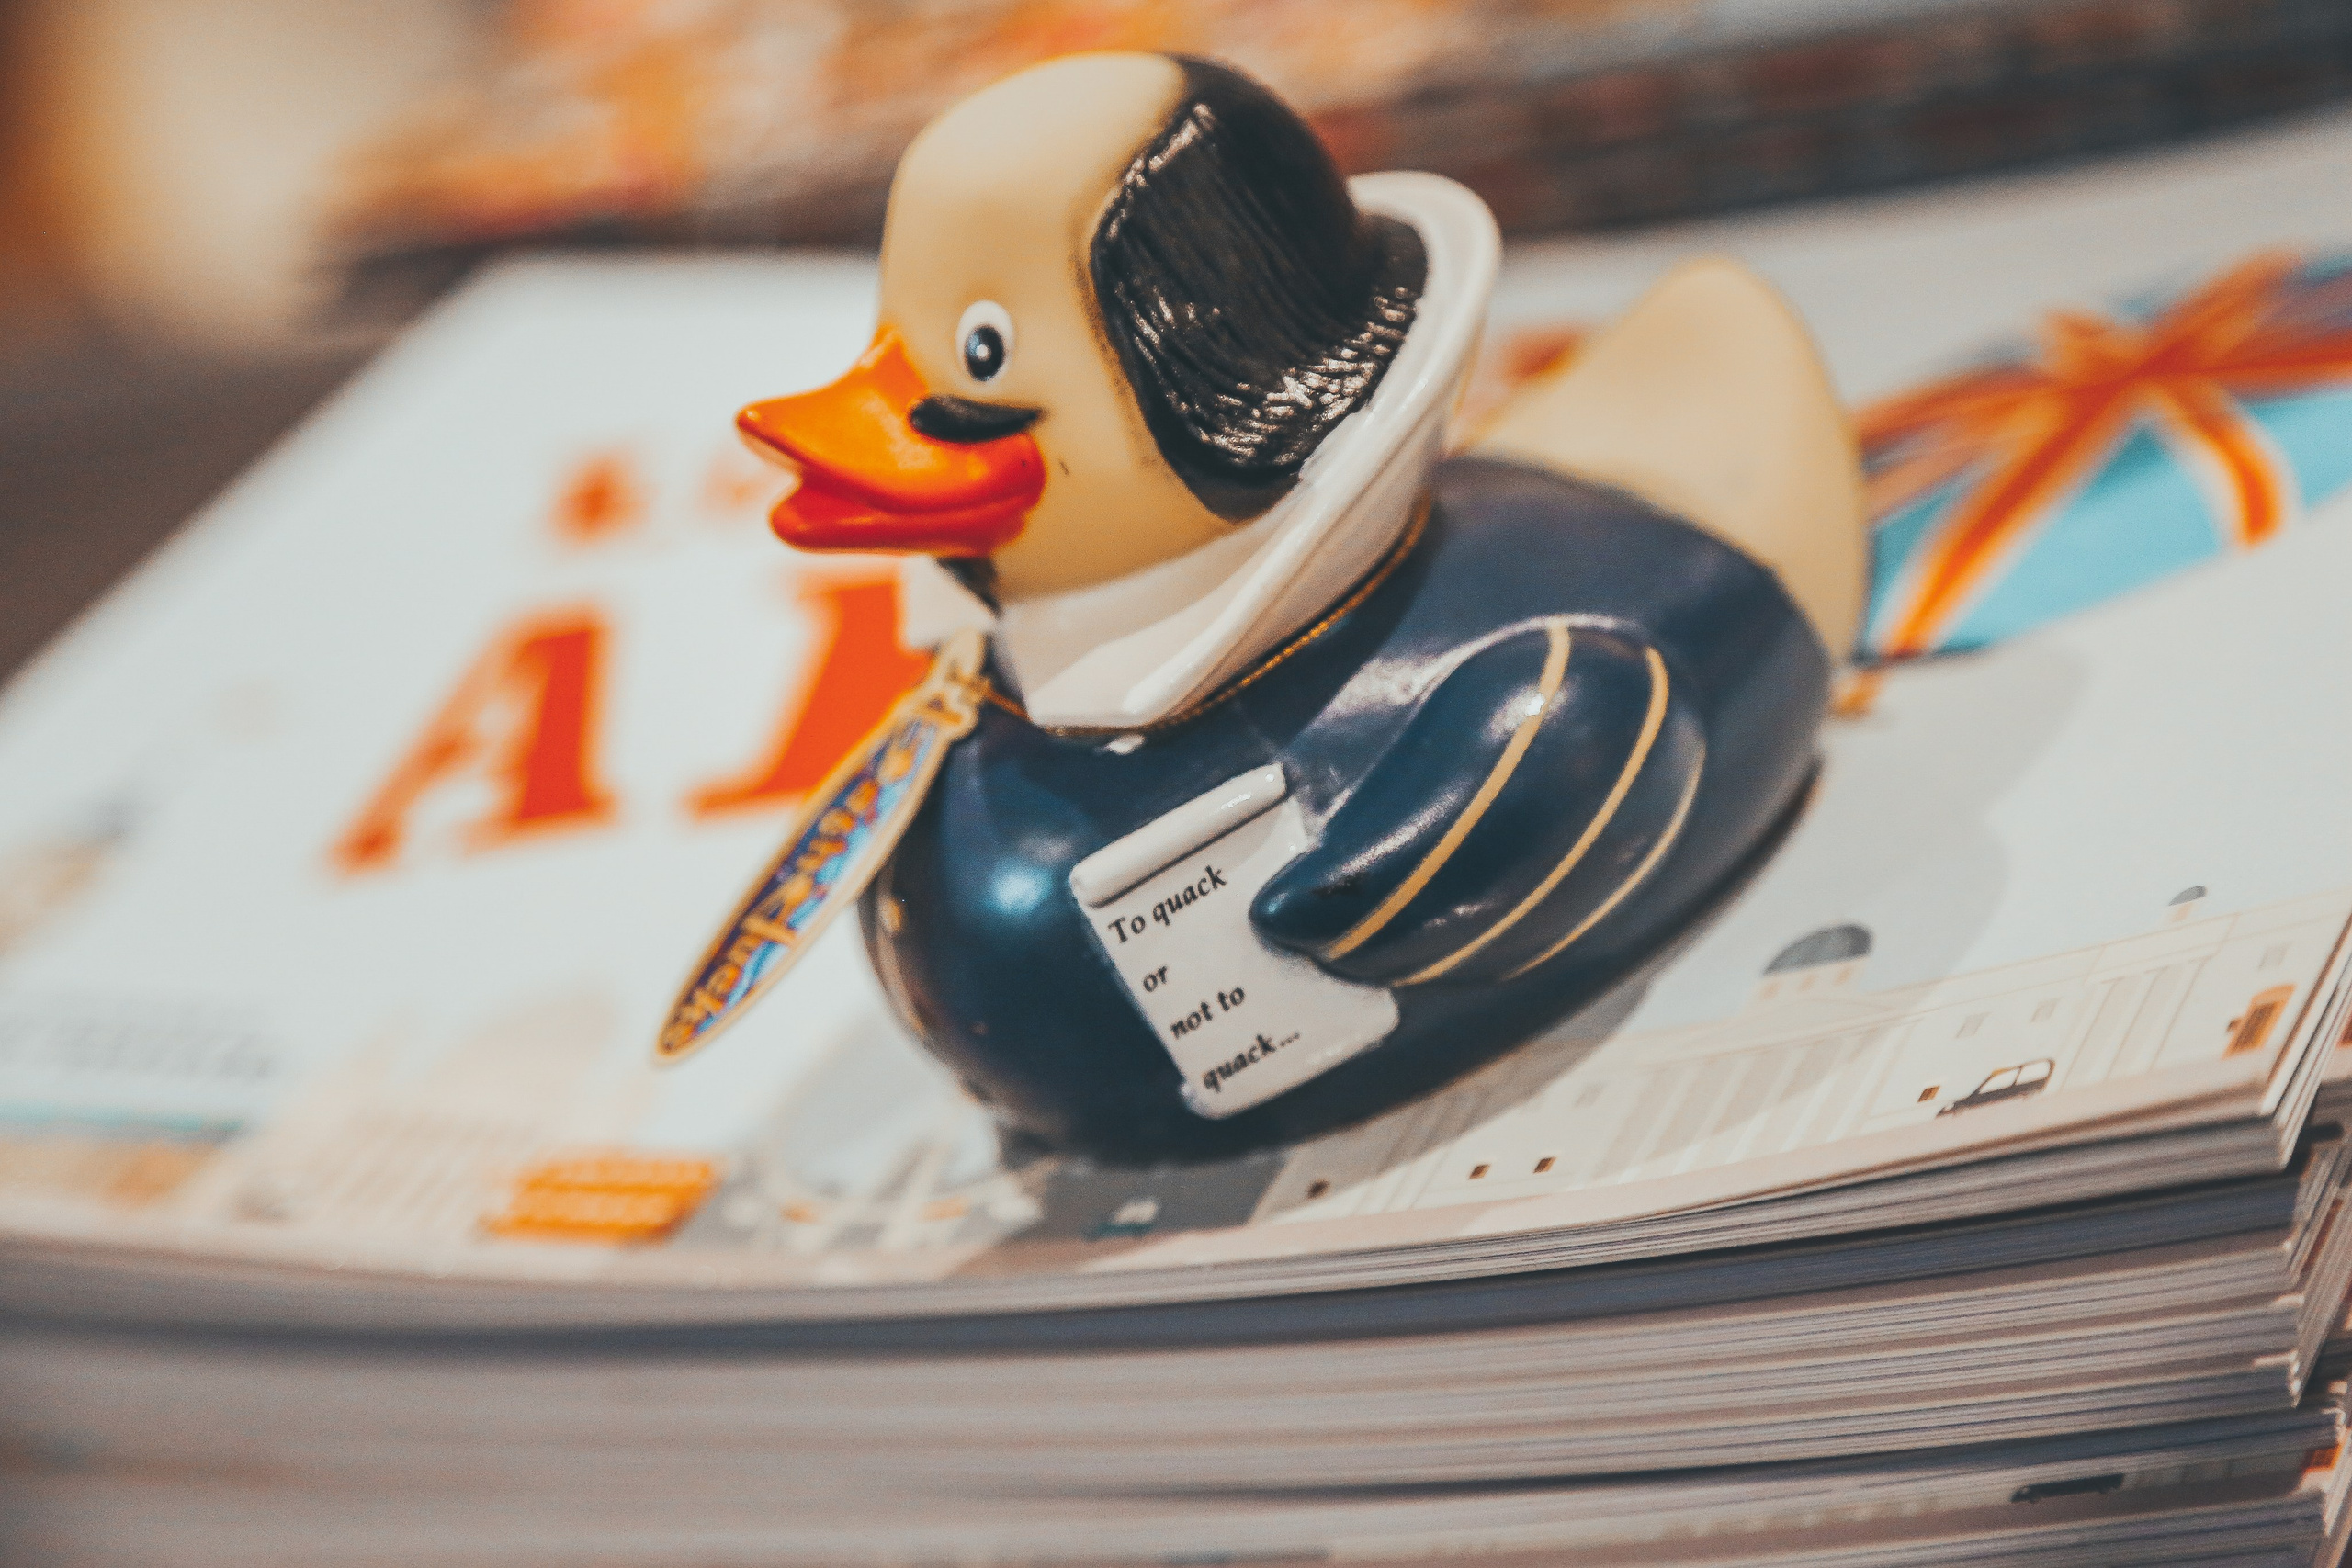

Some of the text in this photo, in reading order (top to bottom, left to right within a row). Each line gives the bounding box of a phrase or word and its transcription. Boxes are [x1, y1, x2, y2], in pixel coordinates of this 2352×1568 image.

[1107, 864, 1227, 944] To quack
[1142, 965, 1170, 992] or
[1170, 986, 1246, 1040] not to
